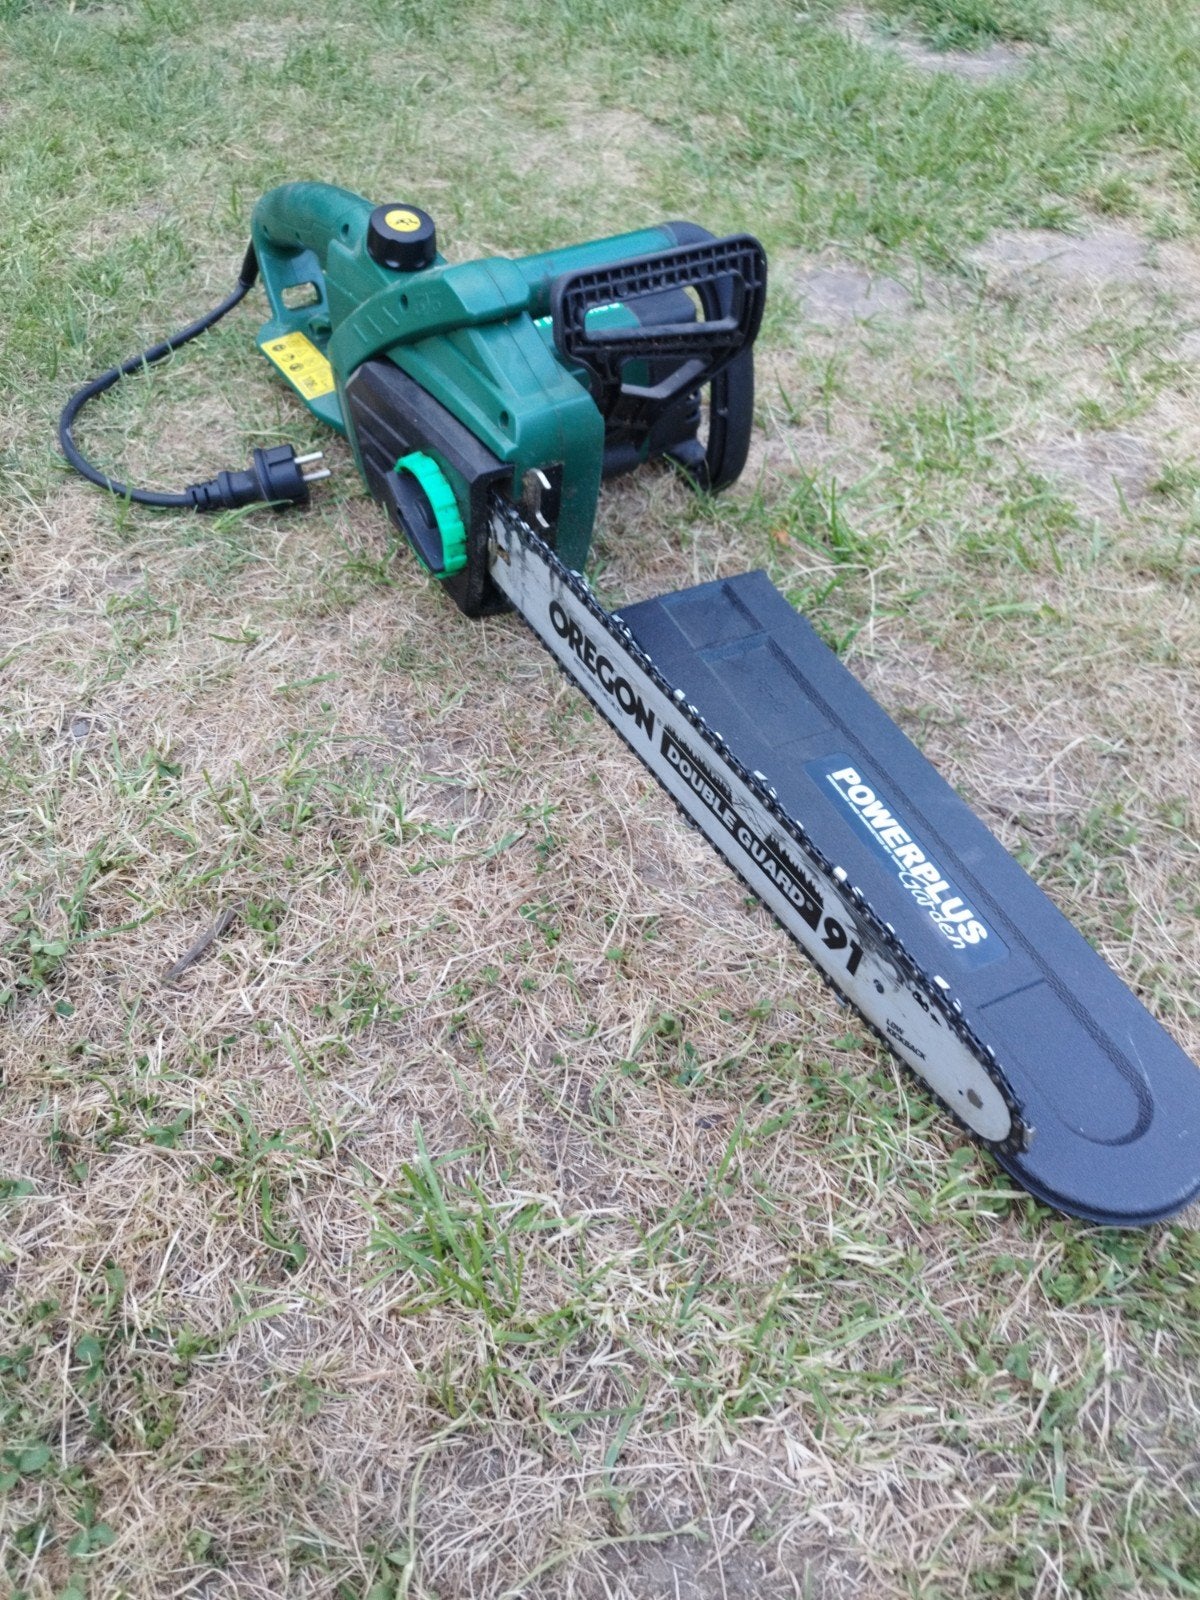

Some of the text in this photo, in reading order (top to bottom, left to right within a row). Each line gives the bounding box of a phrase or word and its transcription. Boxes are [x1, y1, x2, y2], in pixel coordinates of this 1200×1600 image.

[549, 600, 656, 742] OREGON
[666, 743, 864, 977] DOUBLE GUARD 91
[831, 767, 988, 944] POWERPLUS
[898, 871, 966, 949] Garden
[886, 1018, 904, 1035] LOW
[887, 1026, 927, 1061] KICKBACK
